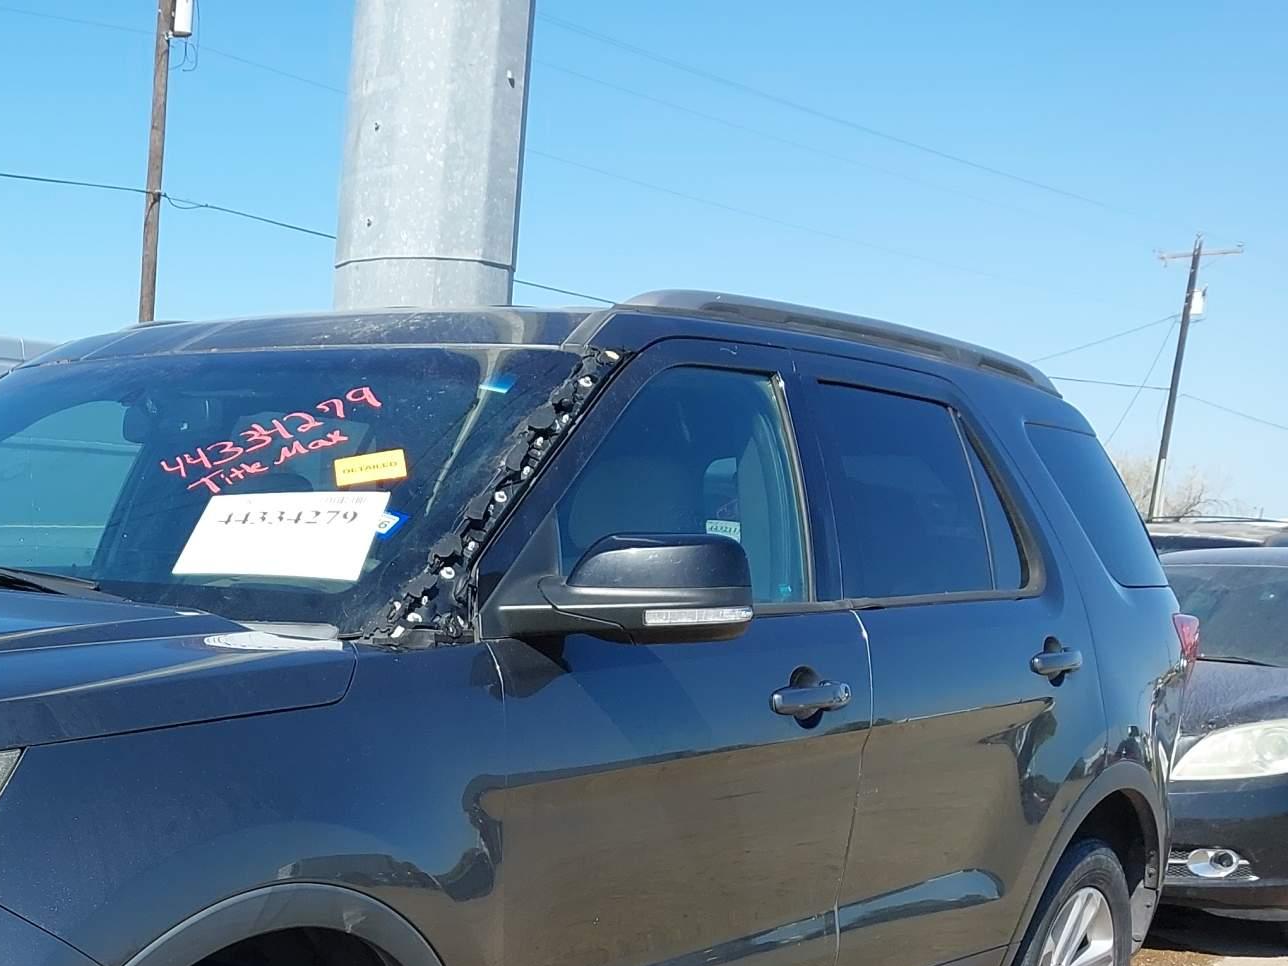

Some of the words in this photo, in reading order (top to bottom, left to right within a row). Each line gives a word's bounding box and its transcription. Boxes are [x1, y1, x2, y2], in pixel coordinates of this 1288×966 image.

[160, 387, 382, 477] 44334279
[274, 430, 349, 465] Max
[342, 461, 398, 474] DETAILED
[217, 510, 358, 525] 44334279
